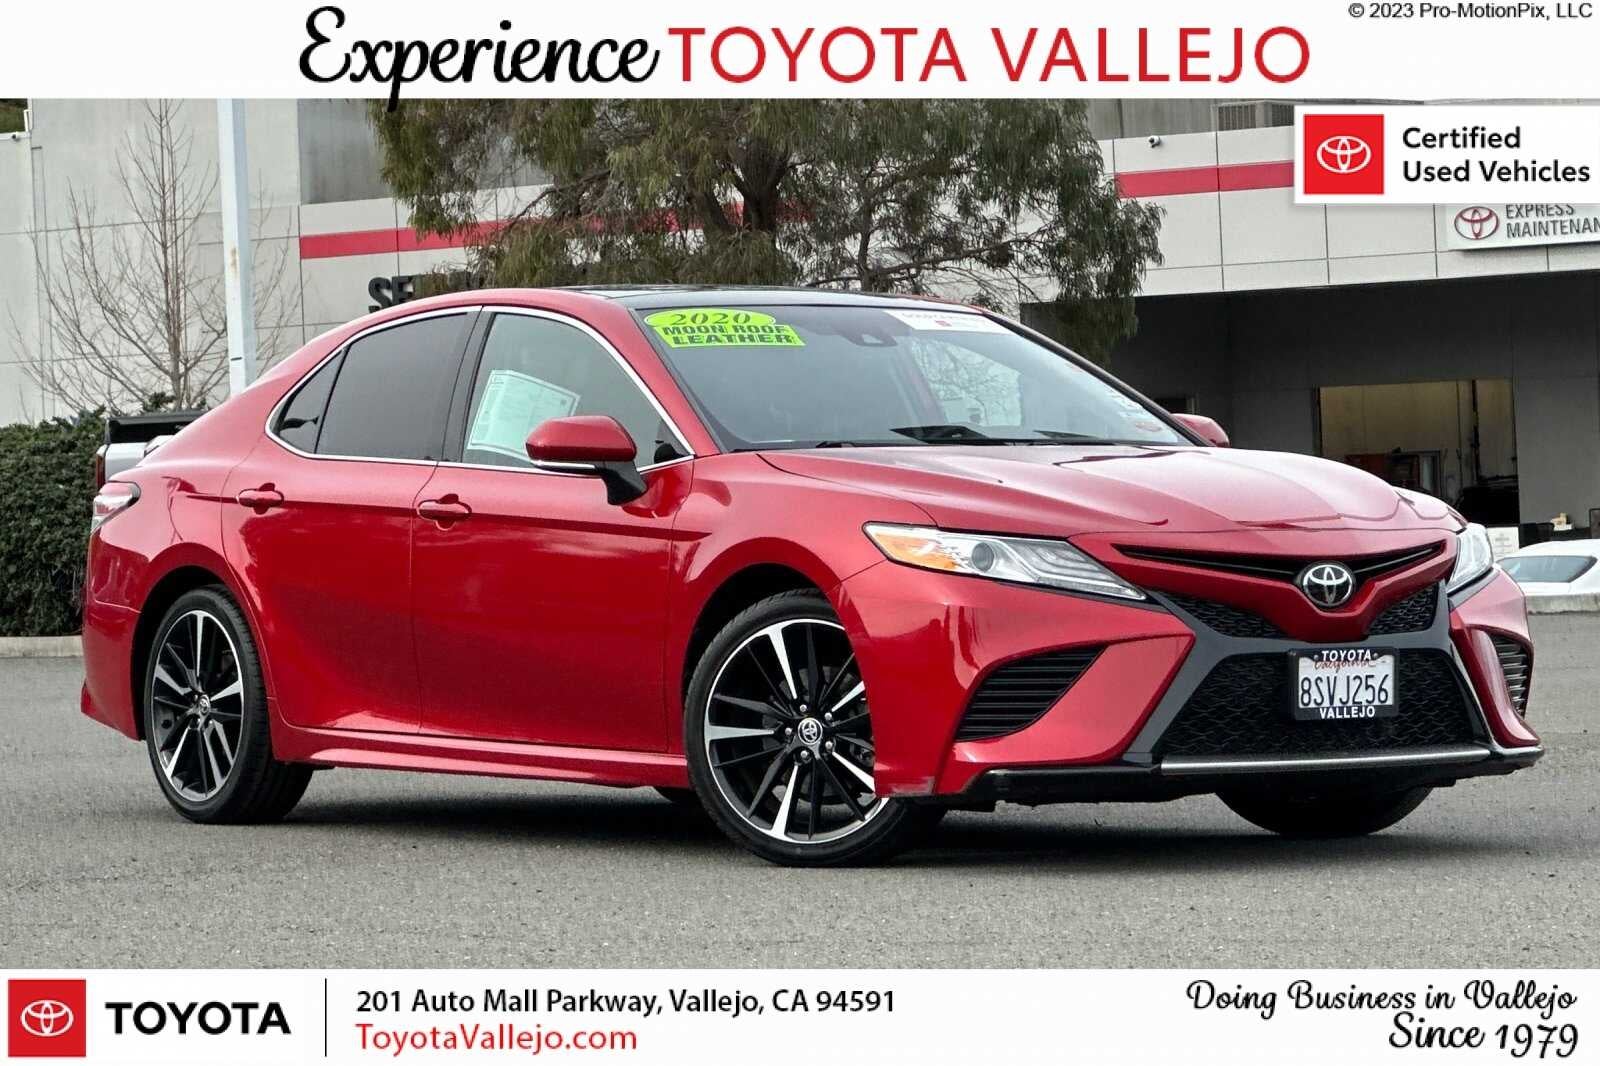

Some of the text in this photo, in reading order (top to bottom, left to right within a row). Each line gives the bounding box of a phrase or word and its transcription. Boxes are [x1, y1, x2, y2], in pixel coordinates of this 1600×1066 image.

[1505, 203, 1574, 219] EXPRESS
[671, 312, 751, 326] 2020
[662, 324, 786, 335] MOON ROOF
[672, 334, 792, 345] LEATHER
[1321, 649, 1372, 662] TOYOTA
[1300, 674, 1389, 707] 8SVJ256
[1319, 705, 1376, 719] VALLEJO
